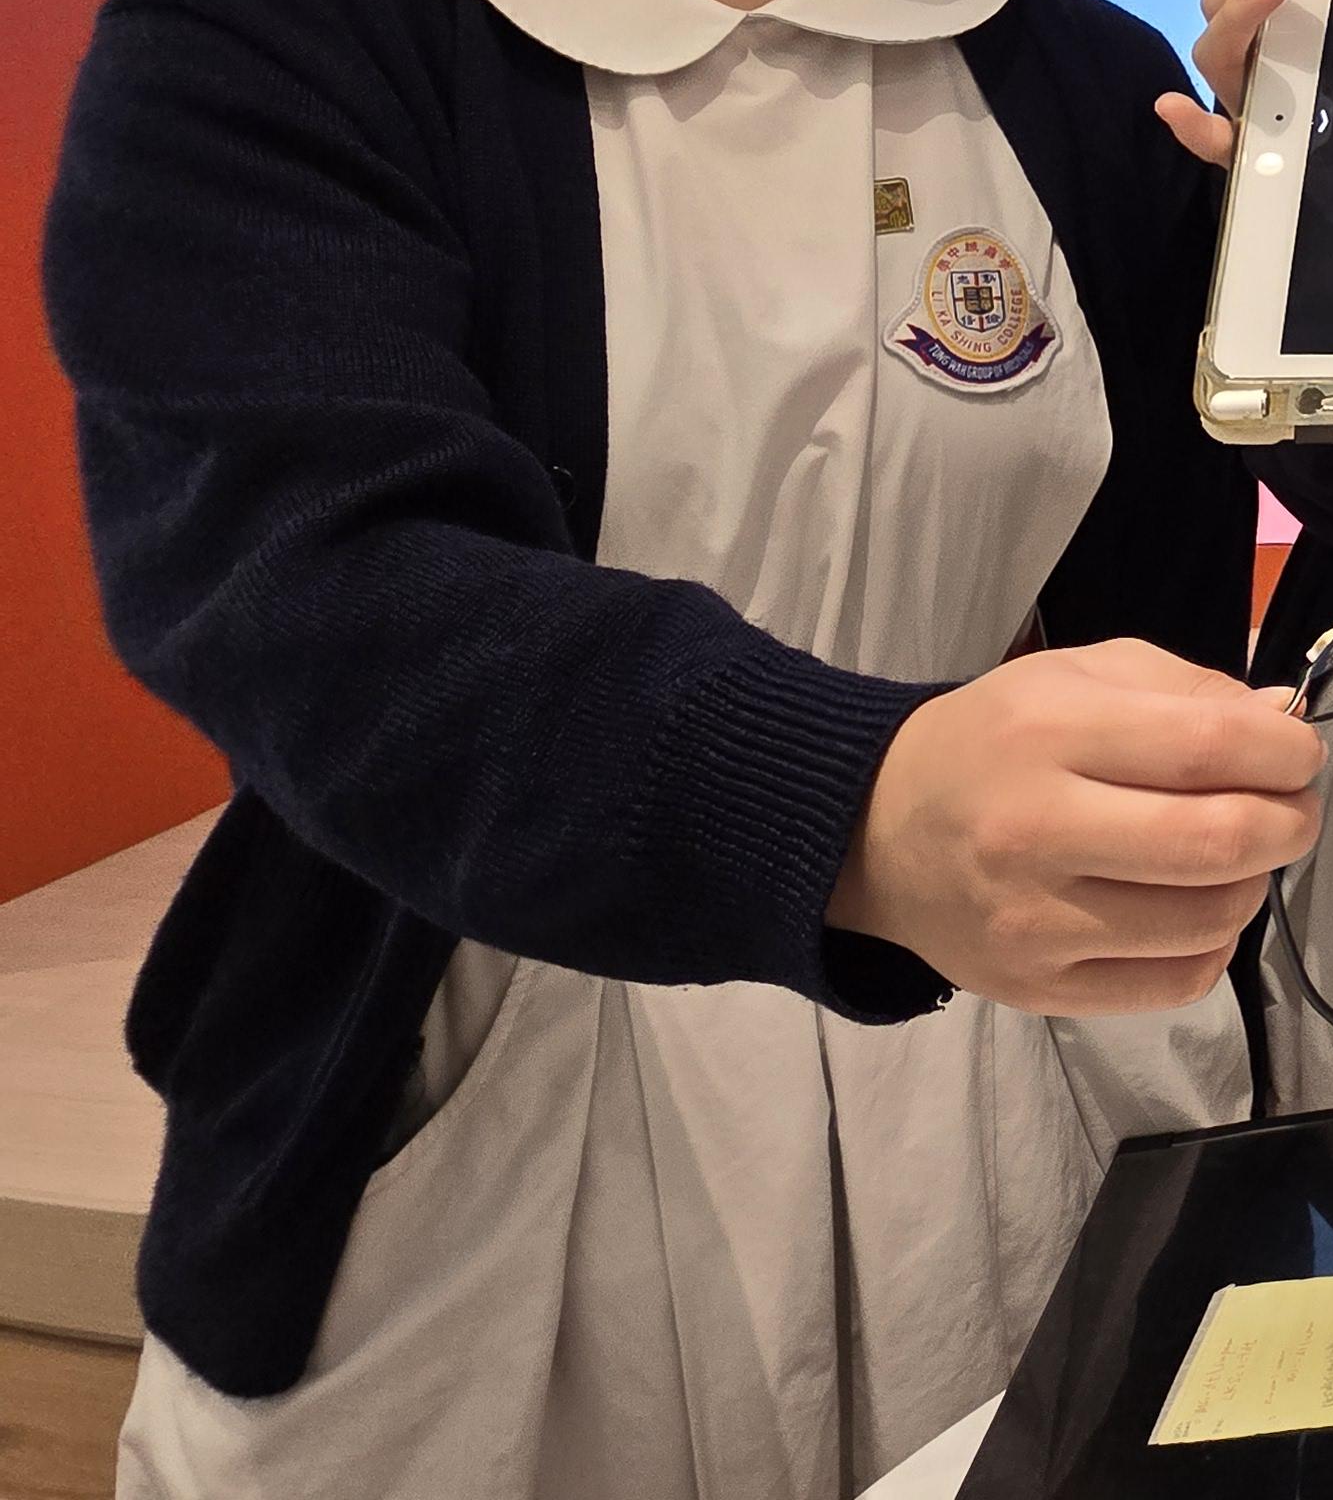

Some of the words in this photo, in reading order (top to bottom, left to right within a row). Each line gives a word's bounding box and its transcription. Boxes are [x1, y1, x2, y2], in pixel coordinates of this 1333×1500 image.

[936, 310, 951, 327] KA
[950, 330, 992, 353] SHING
[997, 289, 1021, 345] COLLEGE
[929, 343, 951, 364] TUNG
